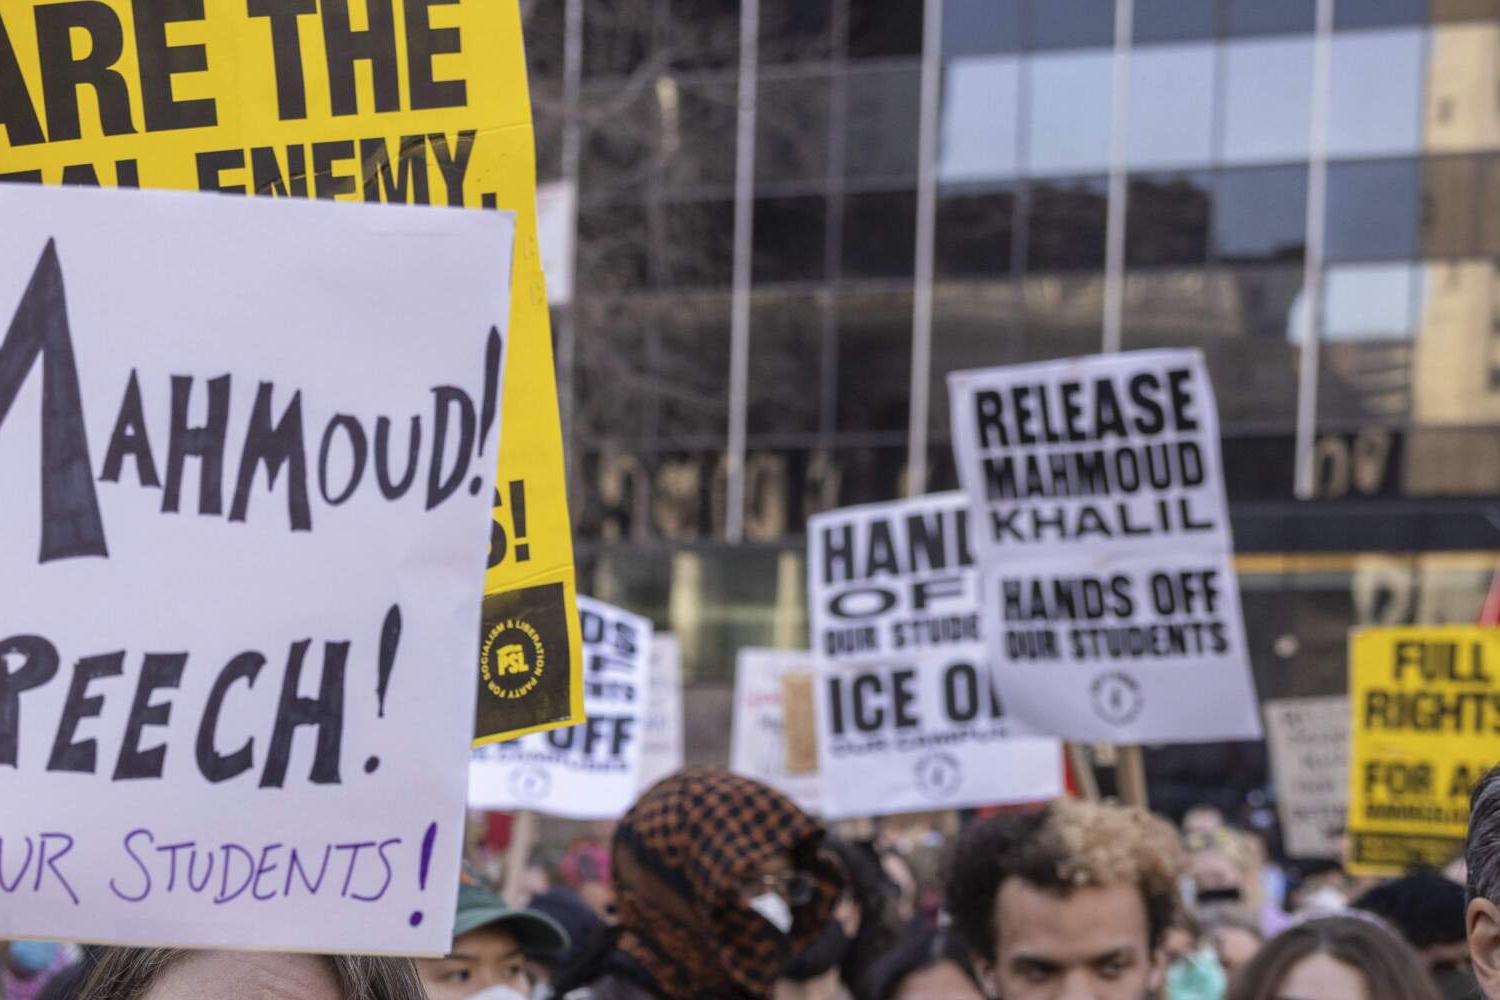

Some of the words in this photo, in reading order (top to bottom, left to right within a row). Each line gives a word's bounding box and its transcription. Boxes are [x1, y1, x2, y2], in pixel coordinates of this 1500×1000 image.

[245, 0, 469, 122] THE
[195, 129, 499, 212] ENEMY.
[975, 369, 1198, 449] RELEASE
[983, 441, 1205, 500] MAHMOUD
[988, 499, 1216, 544] KHALIL
[1002, 573, 1133, 622] HANDS
[1151, 569, 1218, 617] OFF
[481, 622, 506, 681] SOCIALISM
[496, 643, 529, 676] PSL
[515, 620, 545, 677] LIBERATION
[1006, 628, 1060, 661] OUR
[1070, 622, 1230, 660] STUDENTS
[1393, 642, 1491, 683] FULL
[488, 681, 506, 698] FOR
[508, 677, 539, 699] PARTY
[828, 668, 920, 736] ICE
[1363, 762, 1432, 797] FOR
[108, 820, 439, 928] STUDENTS!
